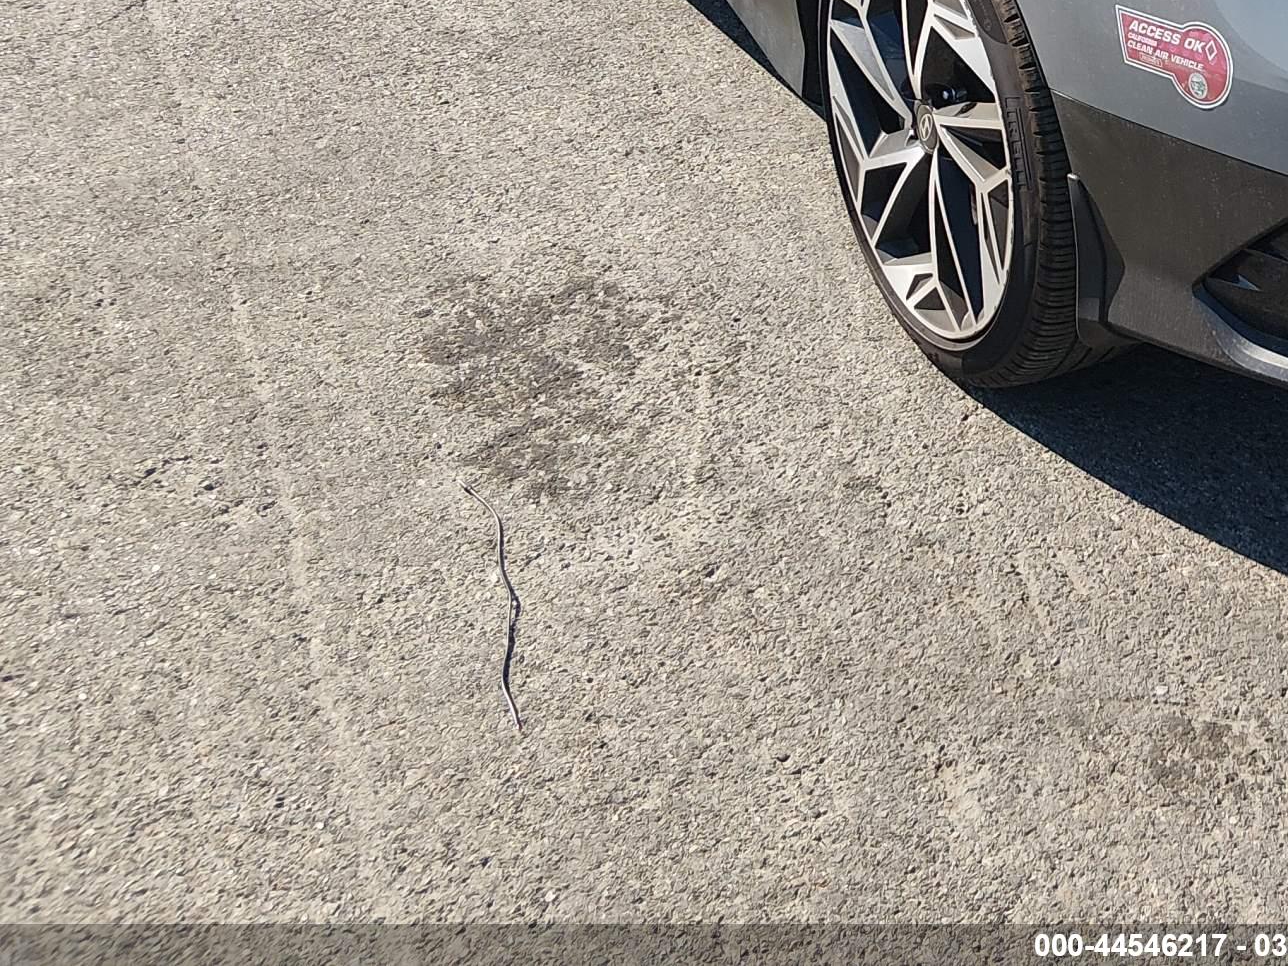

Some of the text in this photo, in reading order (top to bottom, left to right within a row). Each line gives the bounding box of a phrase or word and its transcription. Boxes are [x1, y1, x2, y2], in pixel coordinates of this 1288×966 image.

[1129, 20, 1206, 54] ACCESS OK
[1127, 40, 1154, 55] CLEAN
[1154, 49, 1169, 60] AIR
[1170, 54, 1205, 71] VEHICLE
